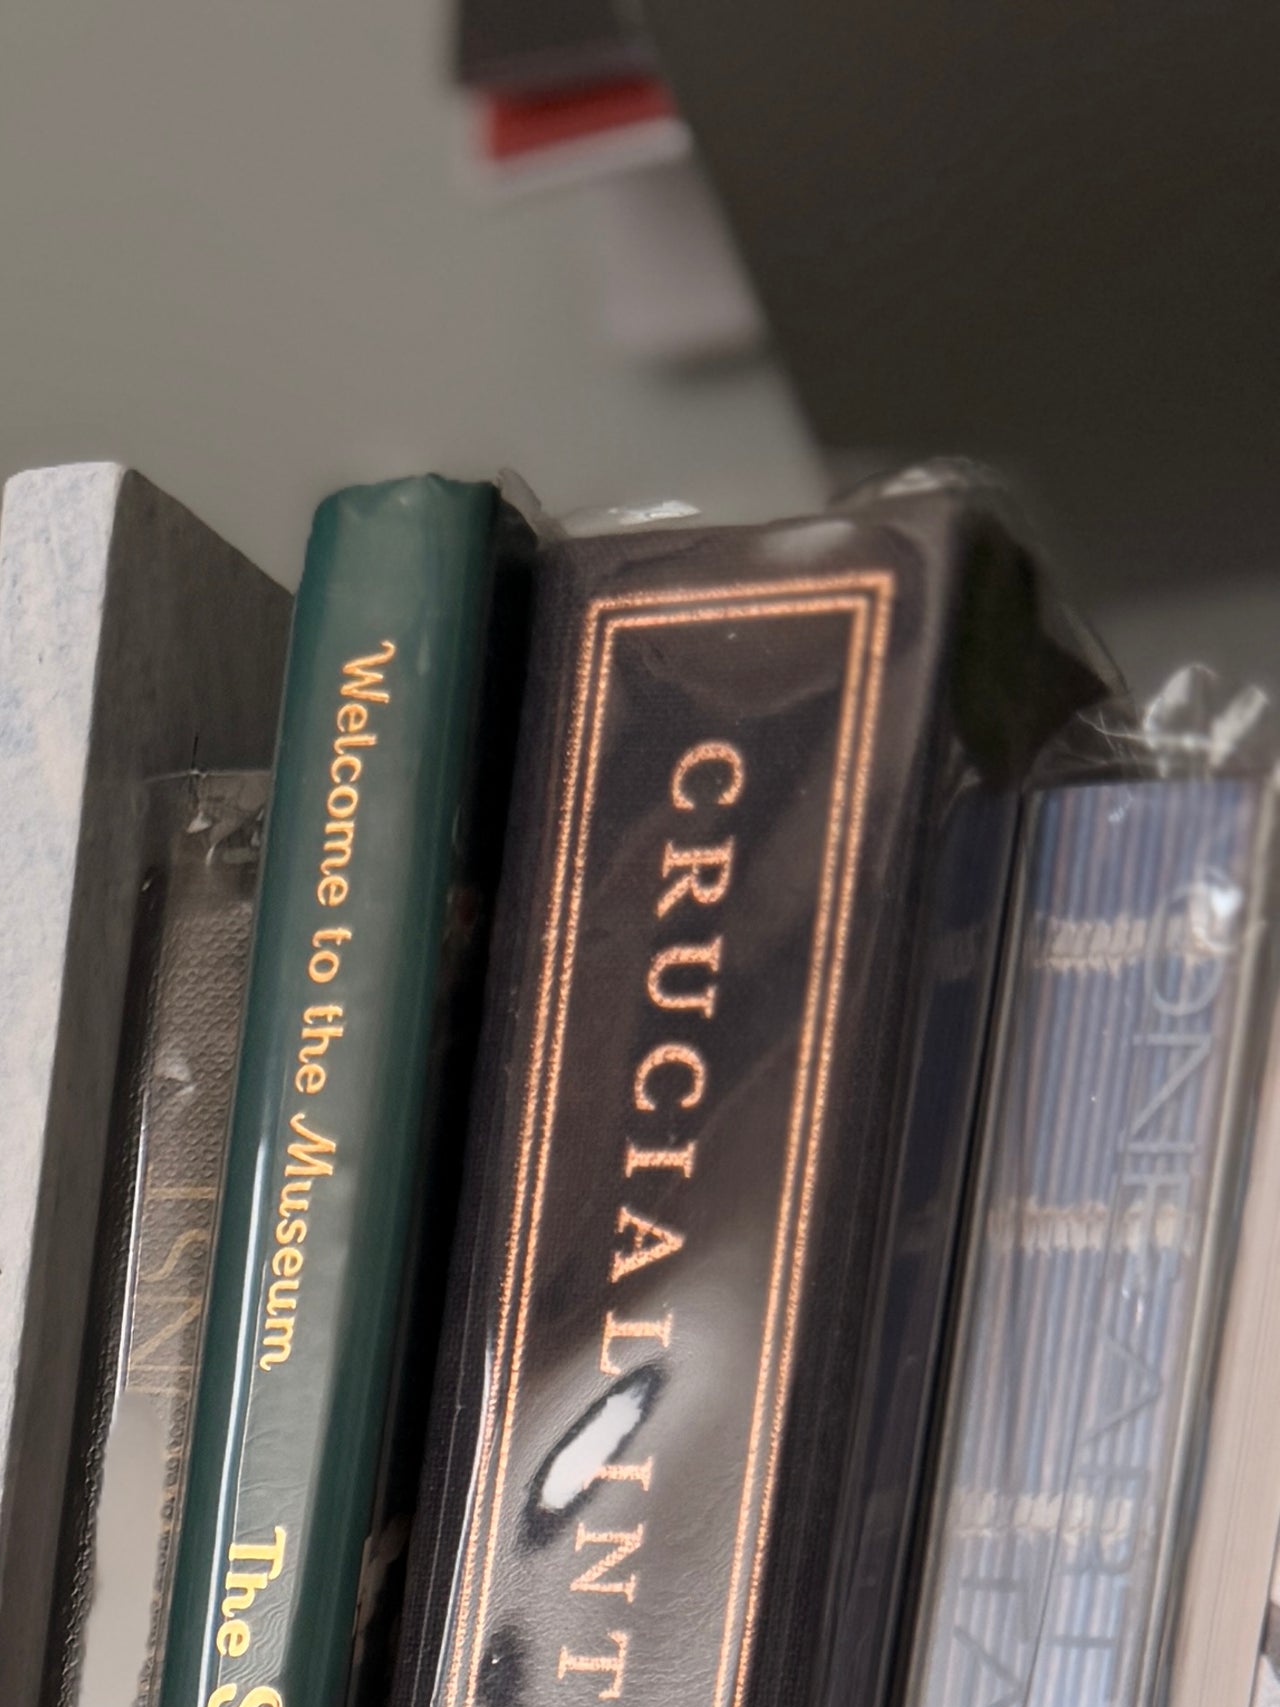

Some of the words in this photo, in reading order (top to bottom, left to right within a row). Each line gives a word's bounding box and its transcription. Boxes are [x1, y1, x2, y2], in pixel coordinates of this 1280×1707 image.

[316, 640, 397, 909] Welcome
[293, 1001, 346, 1096] the
[306, 924, 354, 985] to
[597, 738, 746, 1375] CRUCIAL
[258, 1111, 339, 1373] Museum
[215, 1525, 287, 1659] The
[1050, 1320, 1164, 1704] ART
